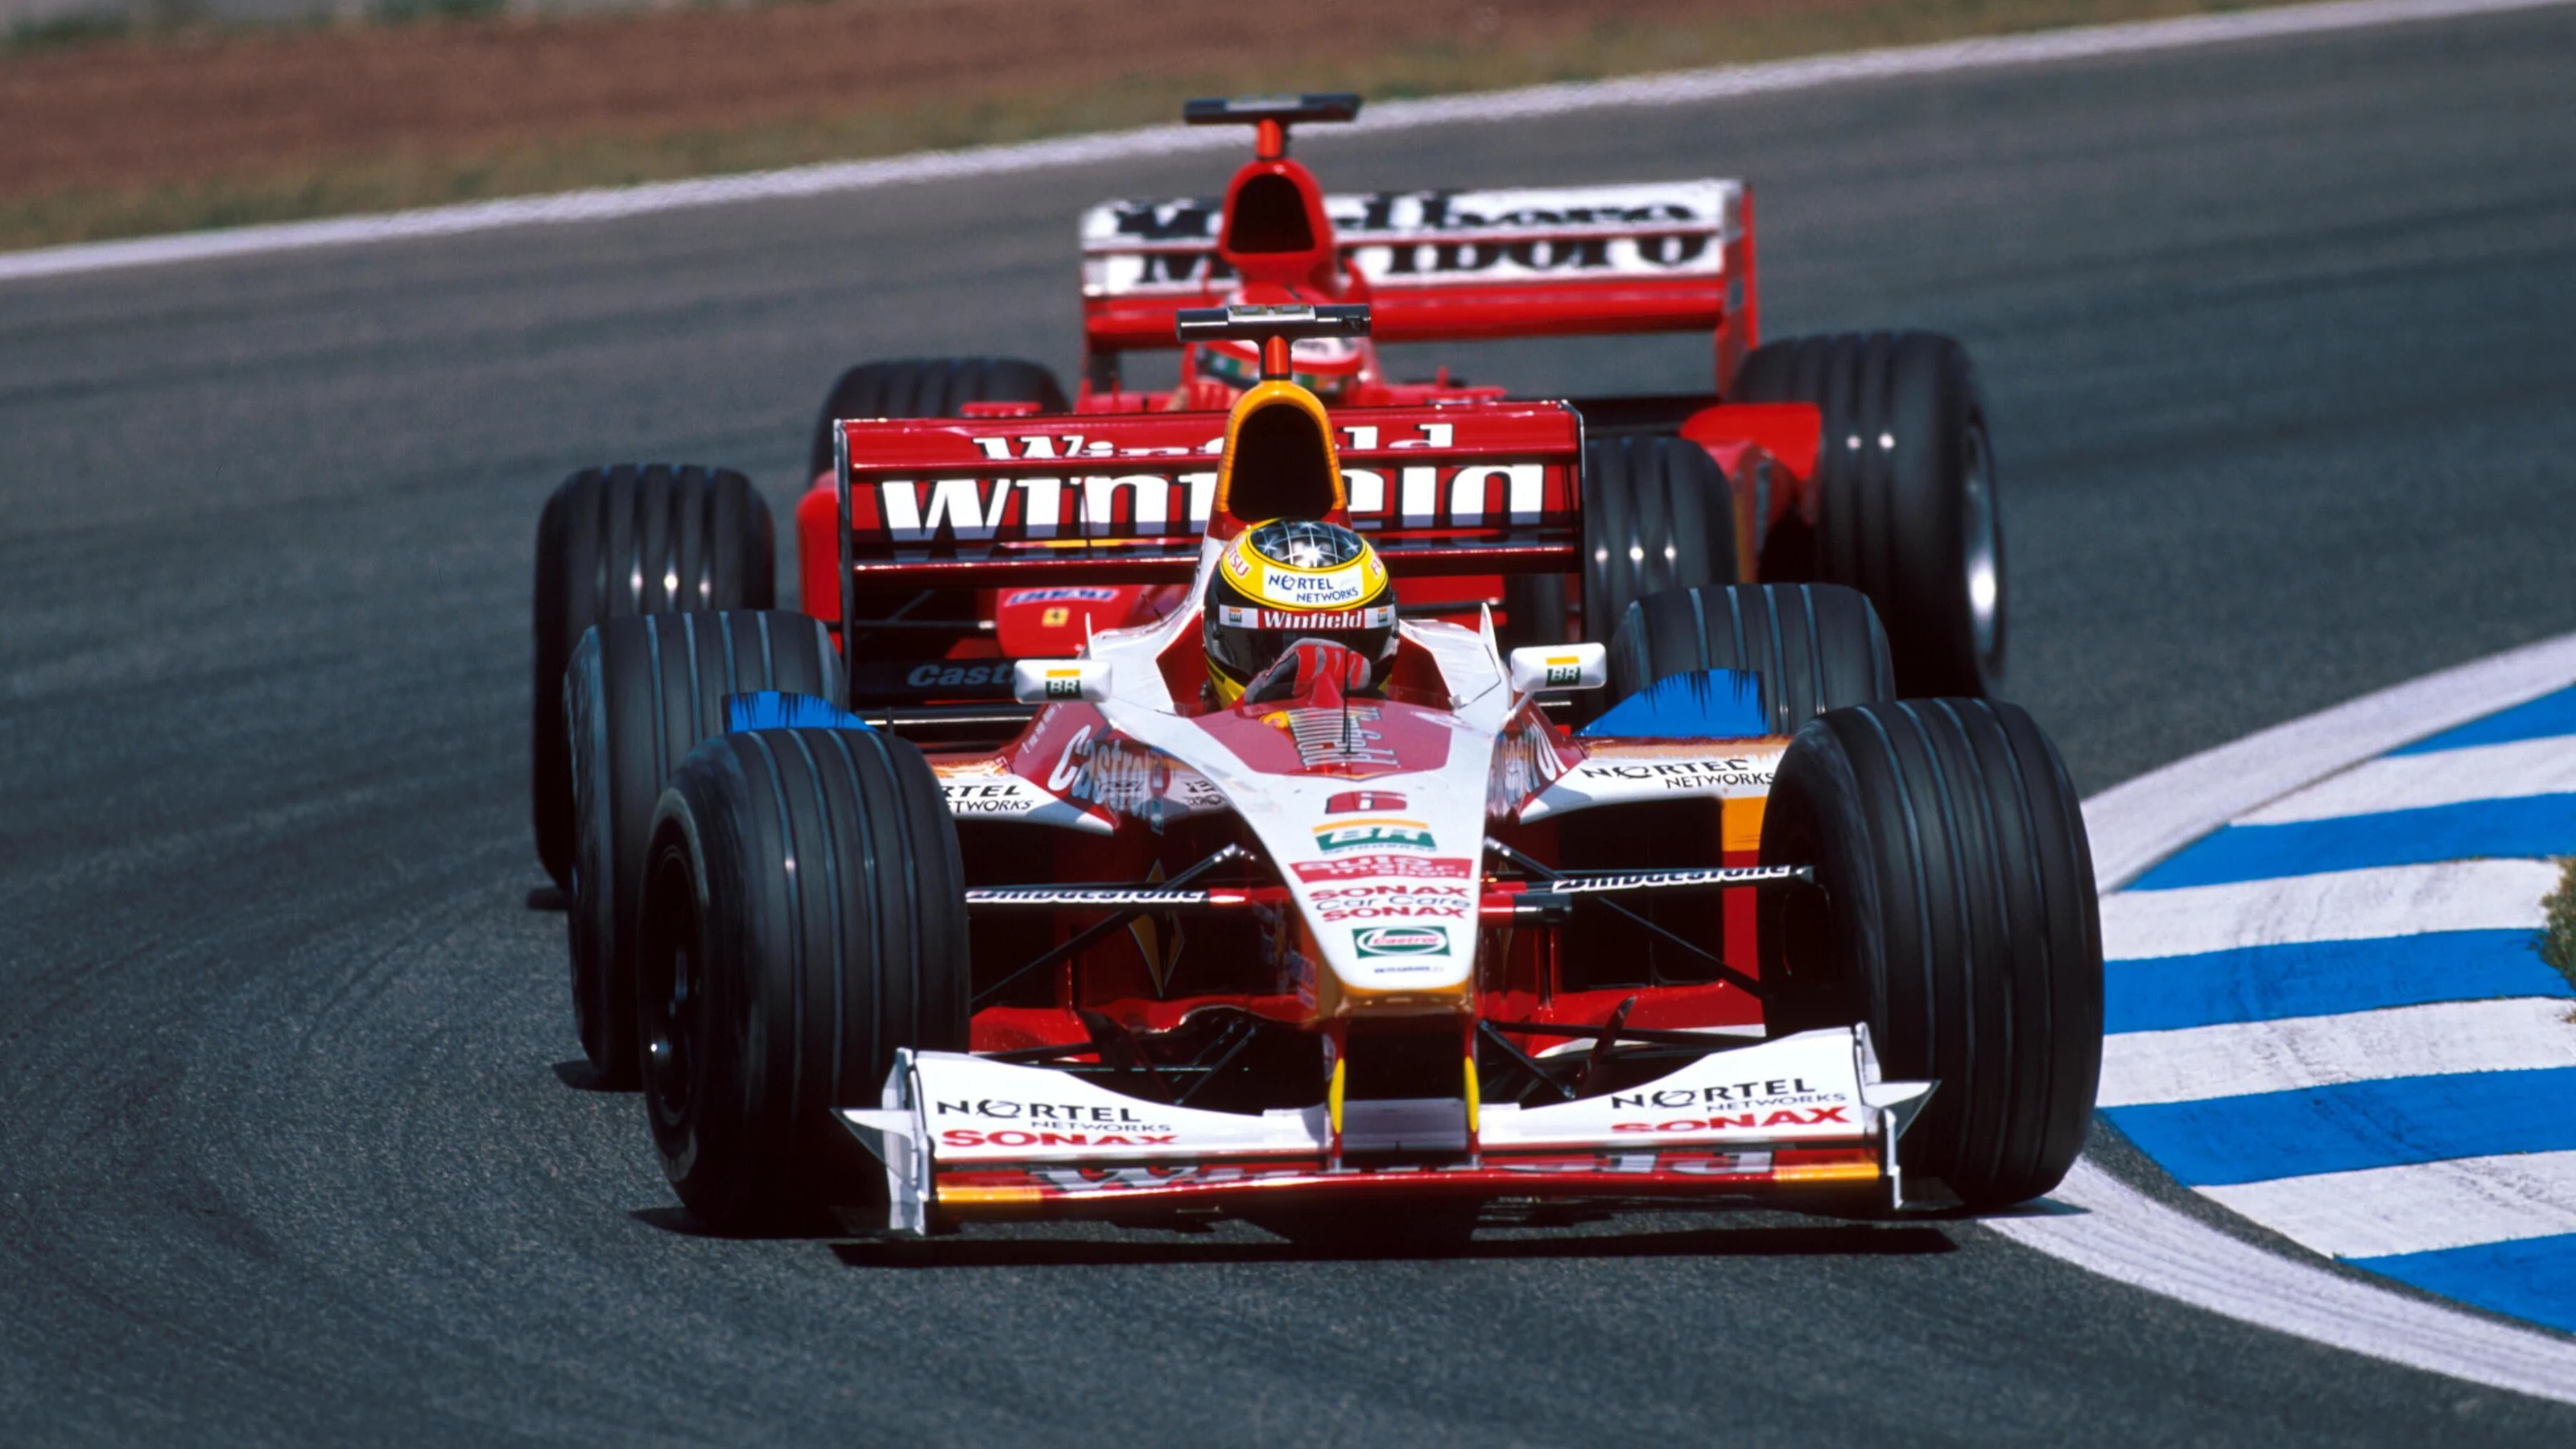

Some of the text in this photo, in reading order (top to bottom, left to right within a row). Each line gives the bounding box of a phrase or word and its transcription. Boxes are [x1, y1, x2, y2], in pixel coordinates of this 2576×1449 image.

[1269, 574, 1333, 591] NORTEL
[1296, 587, 1359, 603] NETWORKS
[1264, 611, 1362, 629] Winfield
[1550, 667, 1577, 681] BR
[1050, 680, 1078, 693] BR
[1665, 771, 1774, 789] NETWORKS
[1325, 791, 1407, 814] 6
[1309, 886, 1470, 901] SONAX
[1316, 895, 1471, 911] Car Care
[1322, 906, 1466, 922] SONAX
[1373, 935, 1439, 945] Castrol
[1612, 1079, 1816, 1109] NORTEL
[1707, 1092, 1847, 1112] NETWORKS
[936, 1099, 1141, 1122] NORTEL
[1612, 1106, 1852, 1132] SONAX
[1031, 1121, 1171, 1132] NETWORKS
[942, 1129, 1179, 1147] SONAX
